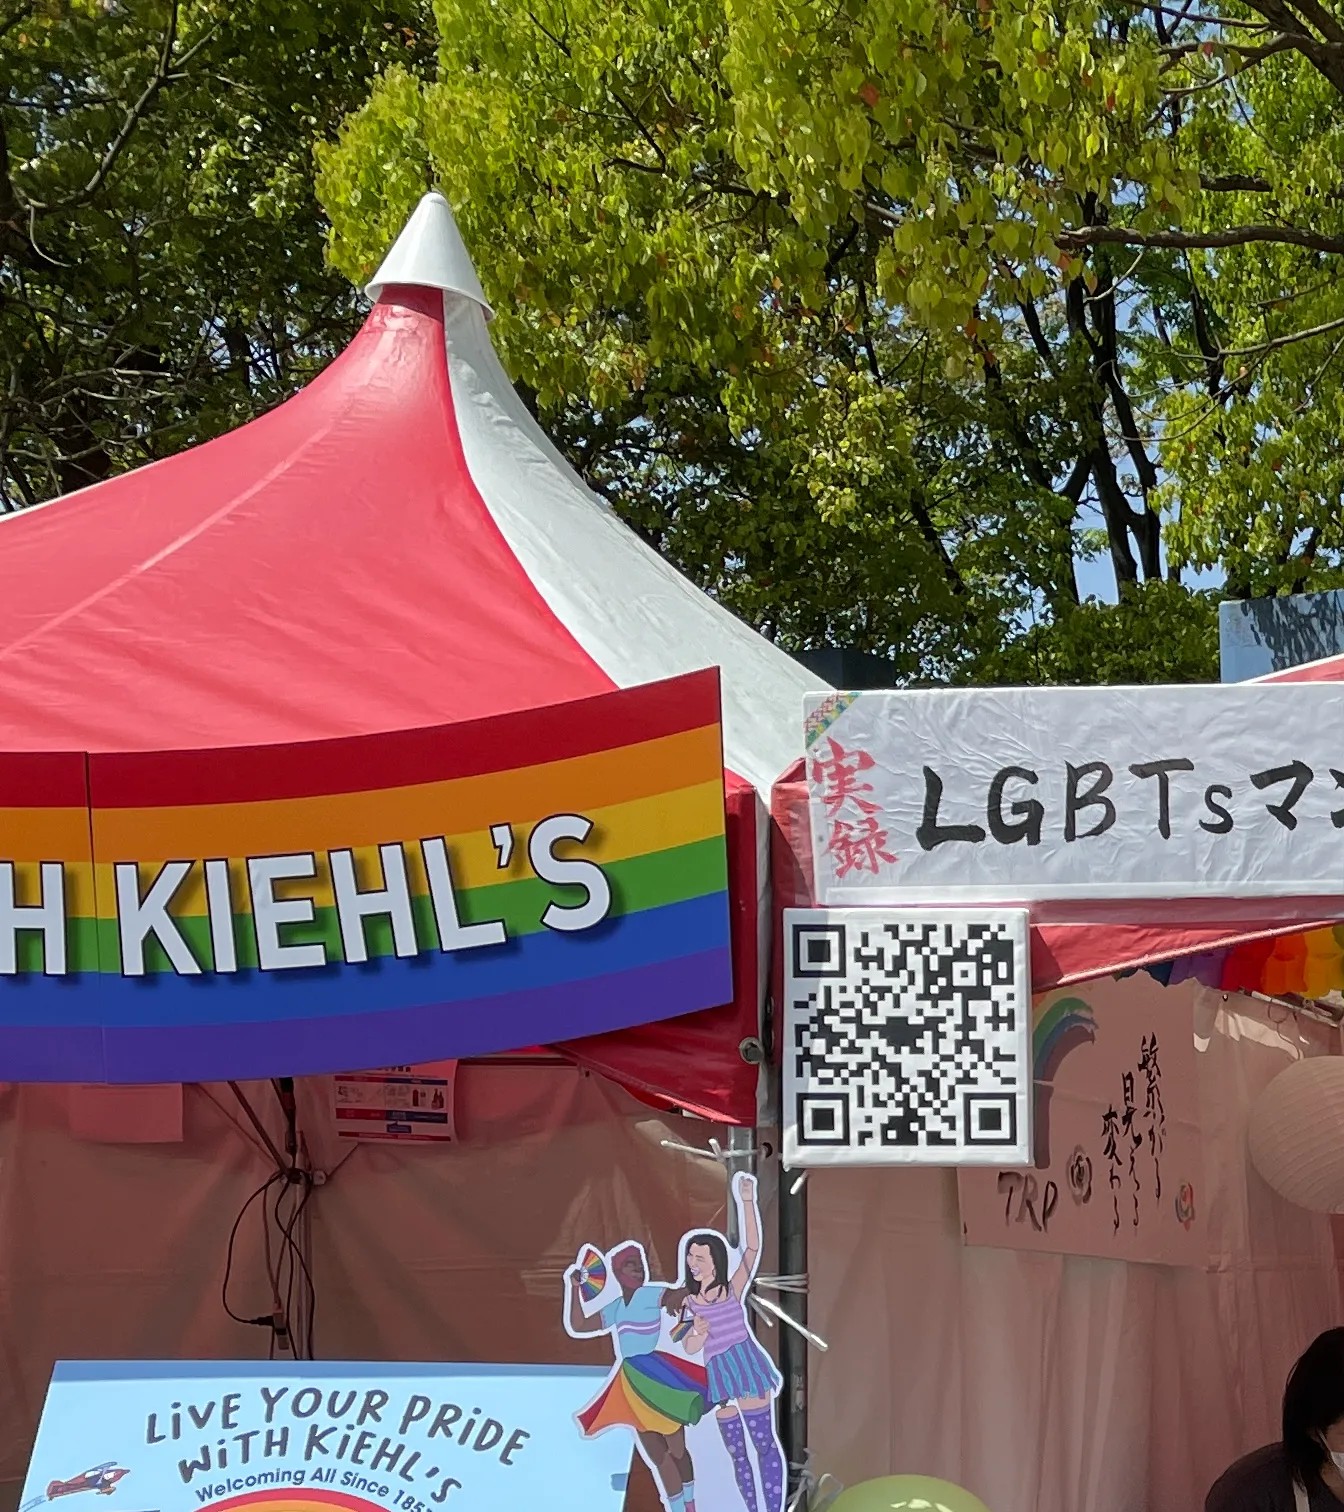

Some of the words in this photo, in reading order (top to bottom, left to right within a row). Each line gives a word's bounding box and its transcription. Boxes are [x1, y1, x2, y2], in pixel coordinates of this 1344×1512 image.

[114, 813, 613, 978] KIEHL'S
[260, 1387, 389, 1426] YOUR
[195, 1466, 306, 1504] Welcoming
[310, 1466, 336, 1485] All
[340, 1470, 391, 1498] Since
